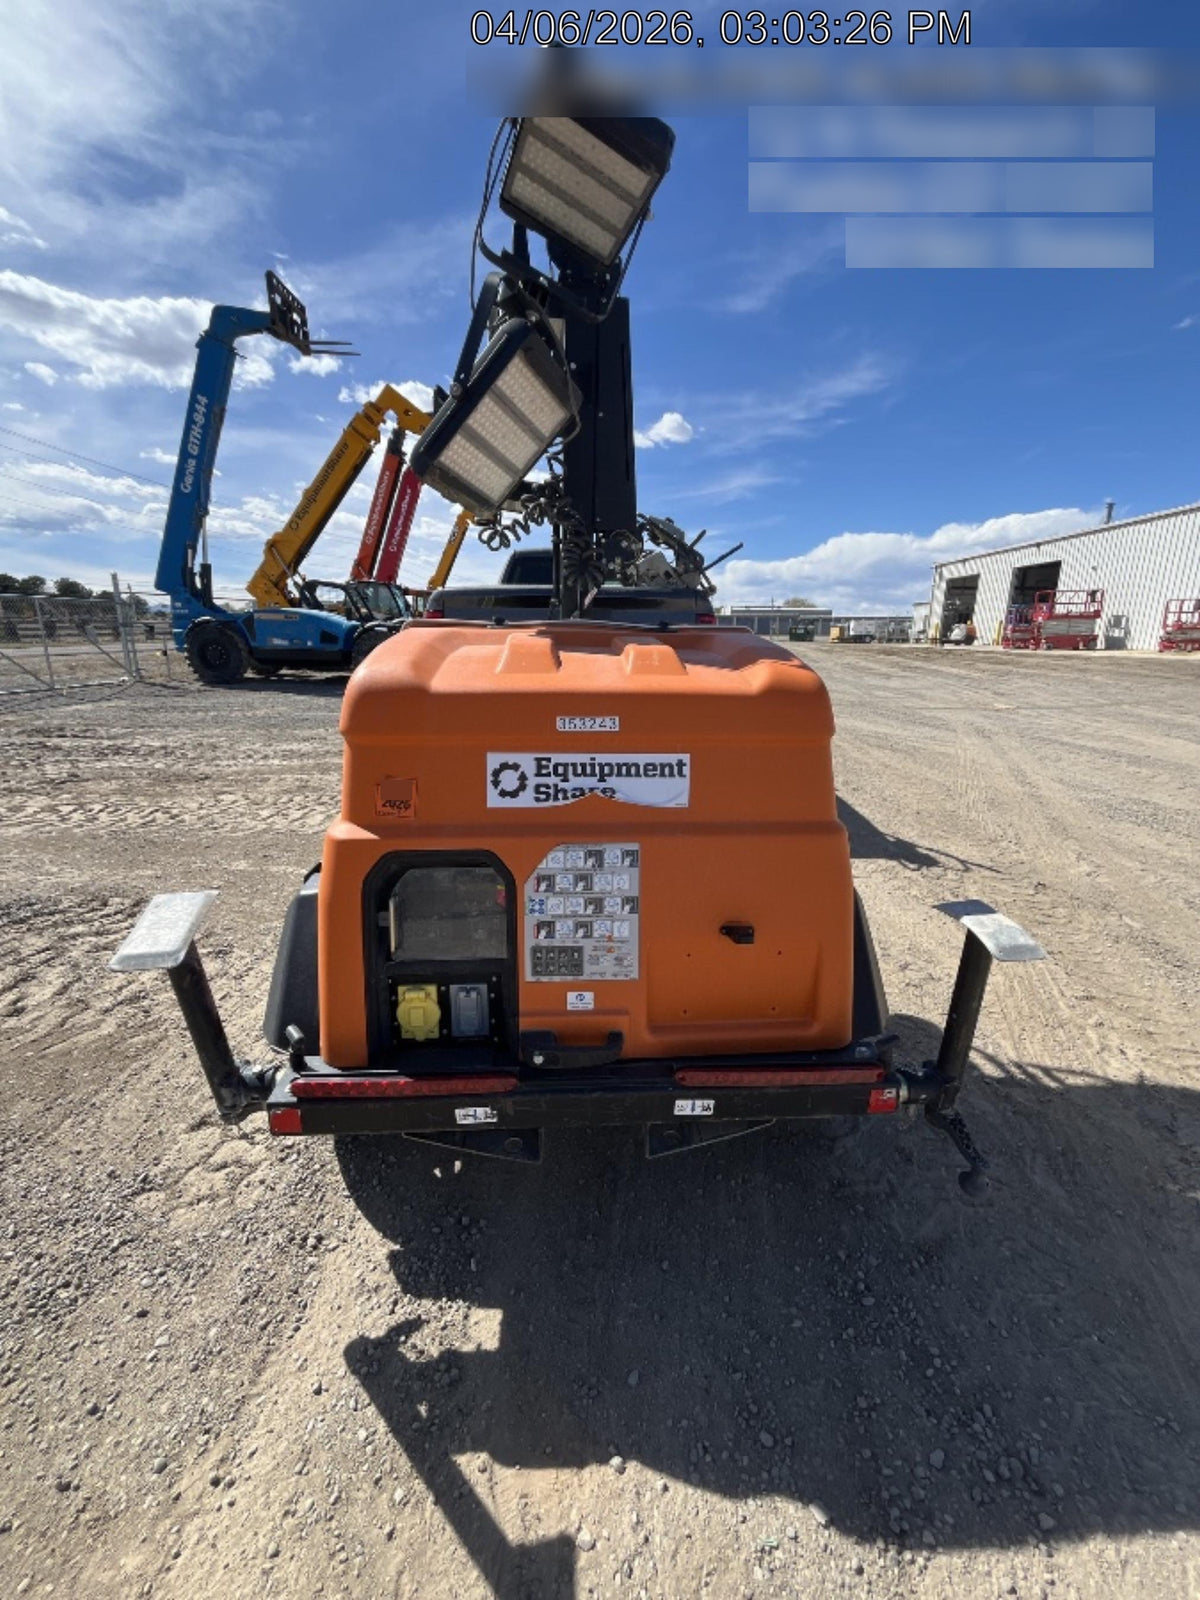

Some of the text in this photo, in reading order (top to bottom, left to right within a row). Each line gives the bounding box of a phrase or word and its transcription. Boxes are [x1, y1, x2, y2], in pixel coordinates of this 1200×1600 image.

[187, 393, 209, 454] GTH-844
[558, 717, 618, 730] 353243
[534, 756, 687, 782] Equipment
